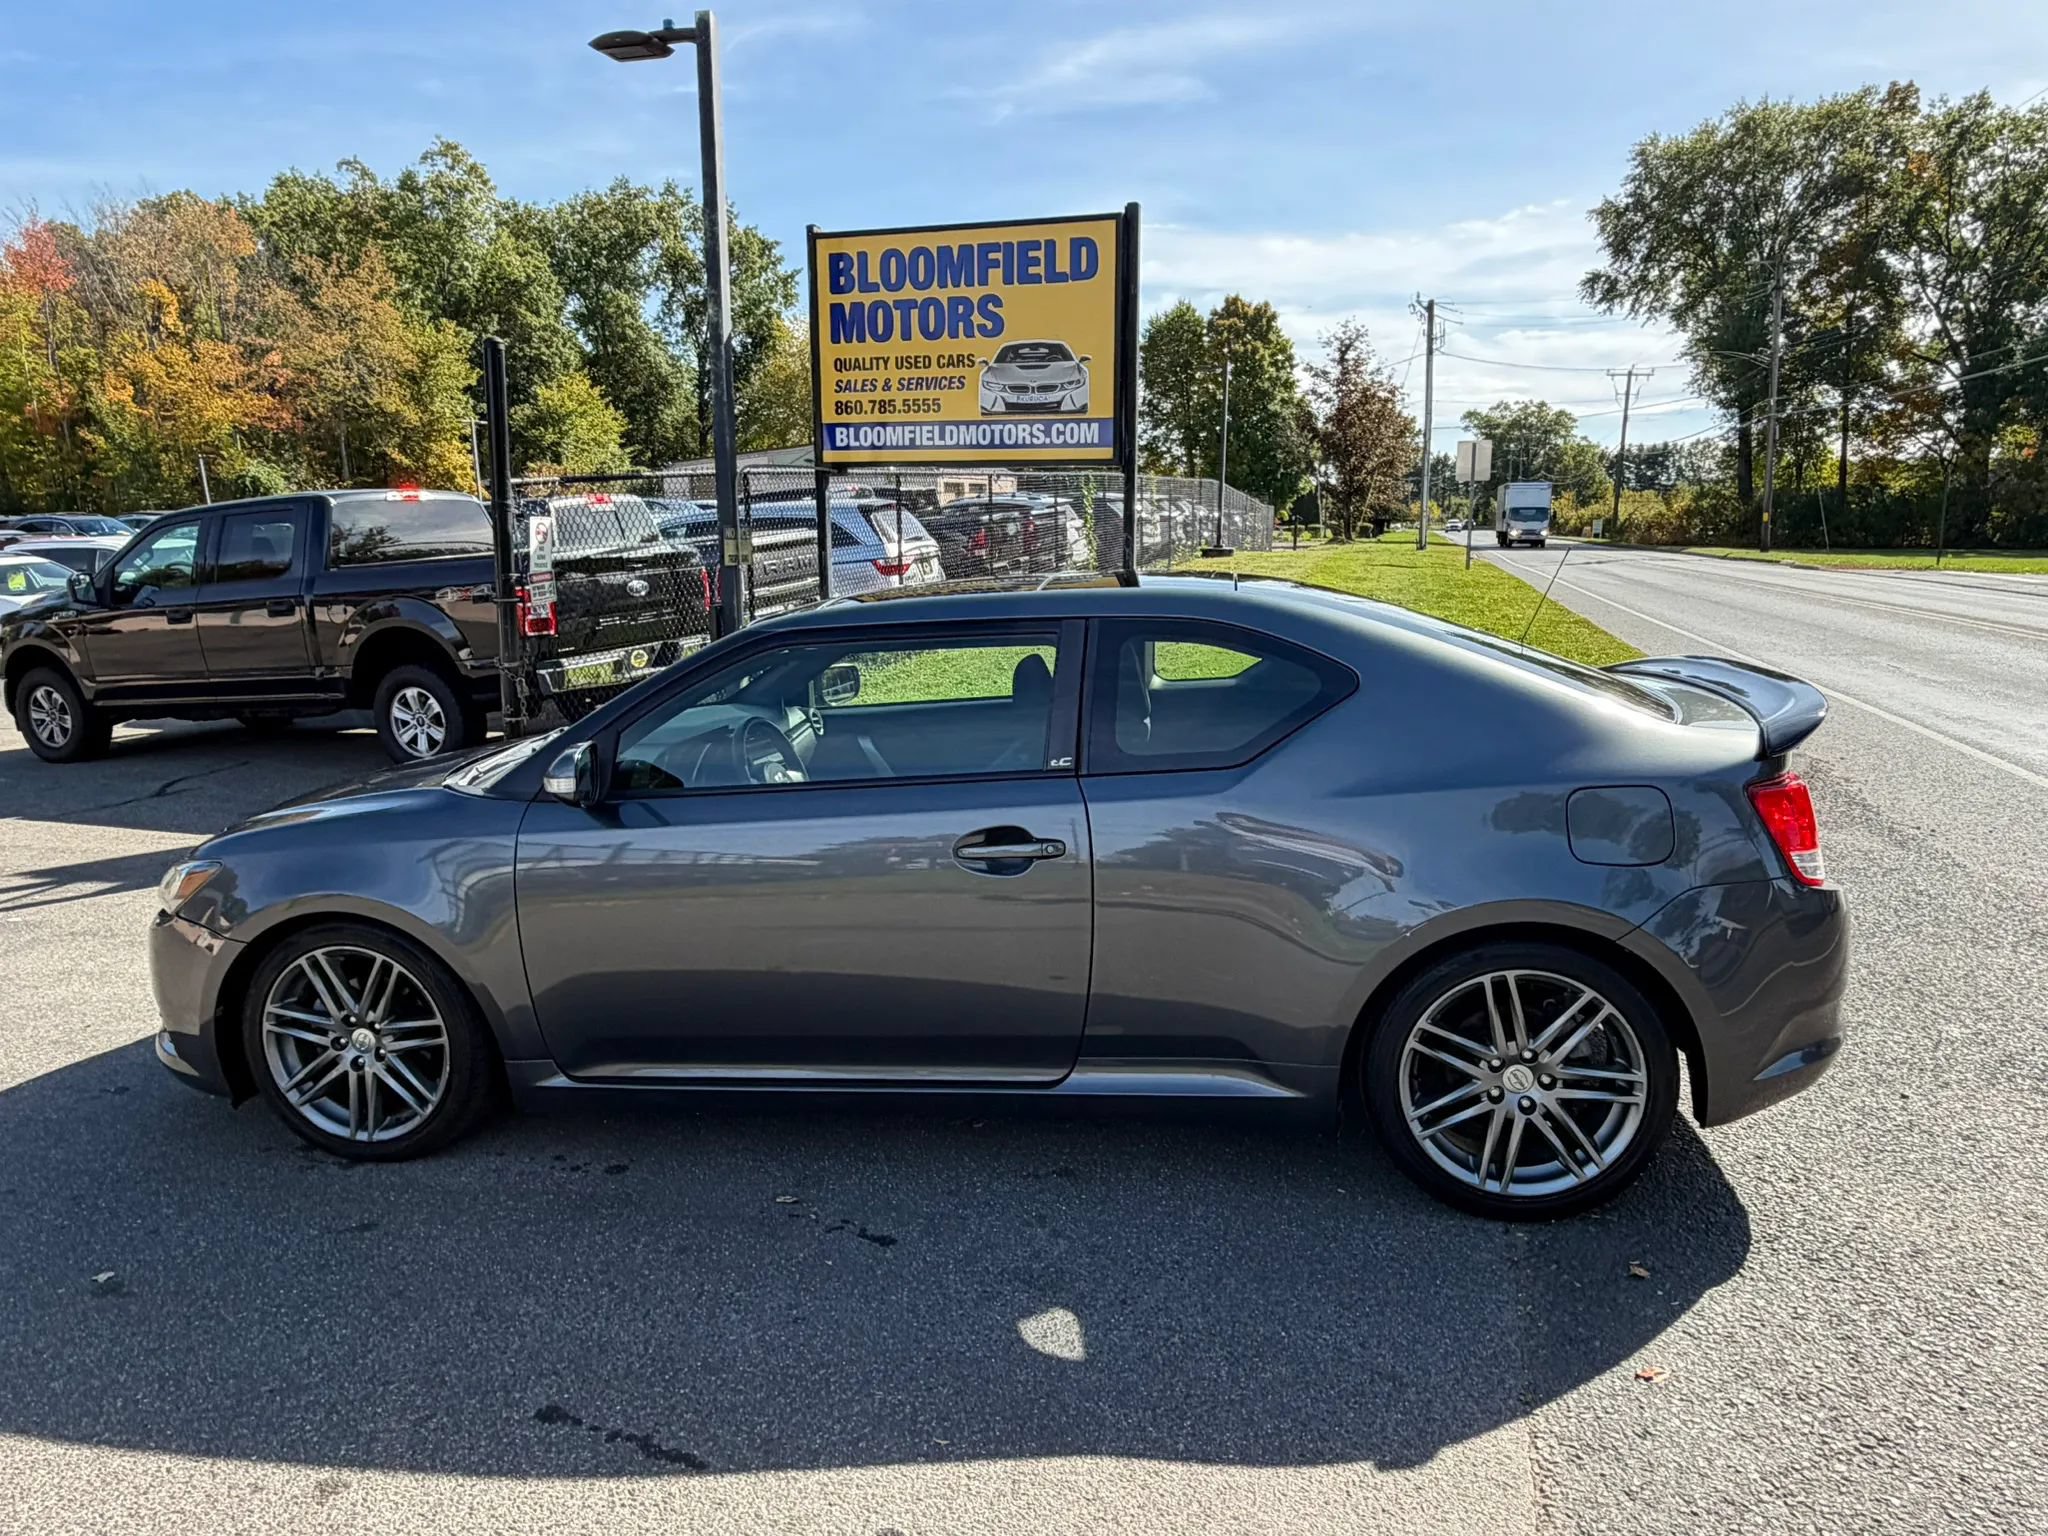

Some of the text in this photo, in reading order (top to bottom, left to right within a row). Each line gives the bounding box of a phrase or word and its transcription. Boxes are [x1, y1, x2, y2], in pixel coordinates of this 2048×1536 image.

[829, 236, 1099, 294] BLOOMFIELD
[830, 293, 1004, 344] MOTORS
[834, 353, 975, 372] QUALITY USED CARS
[834, 375, 966, 393] SALES & SERVICES
[834, 398, 941, 415] 860.785.5555
[835, 422, 1099, 447] BLOOMFIELDMOTORS.COM
